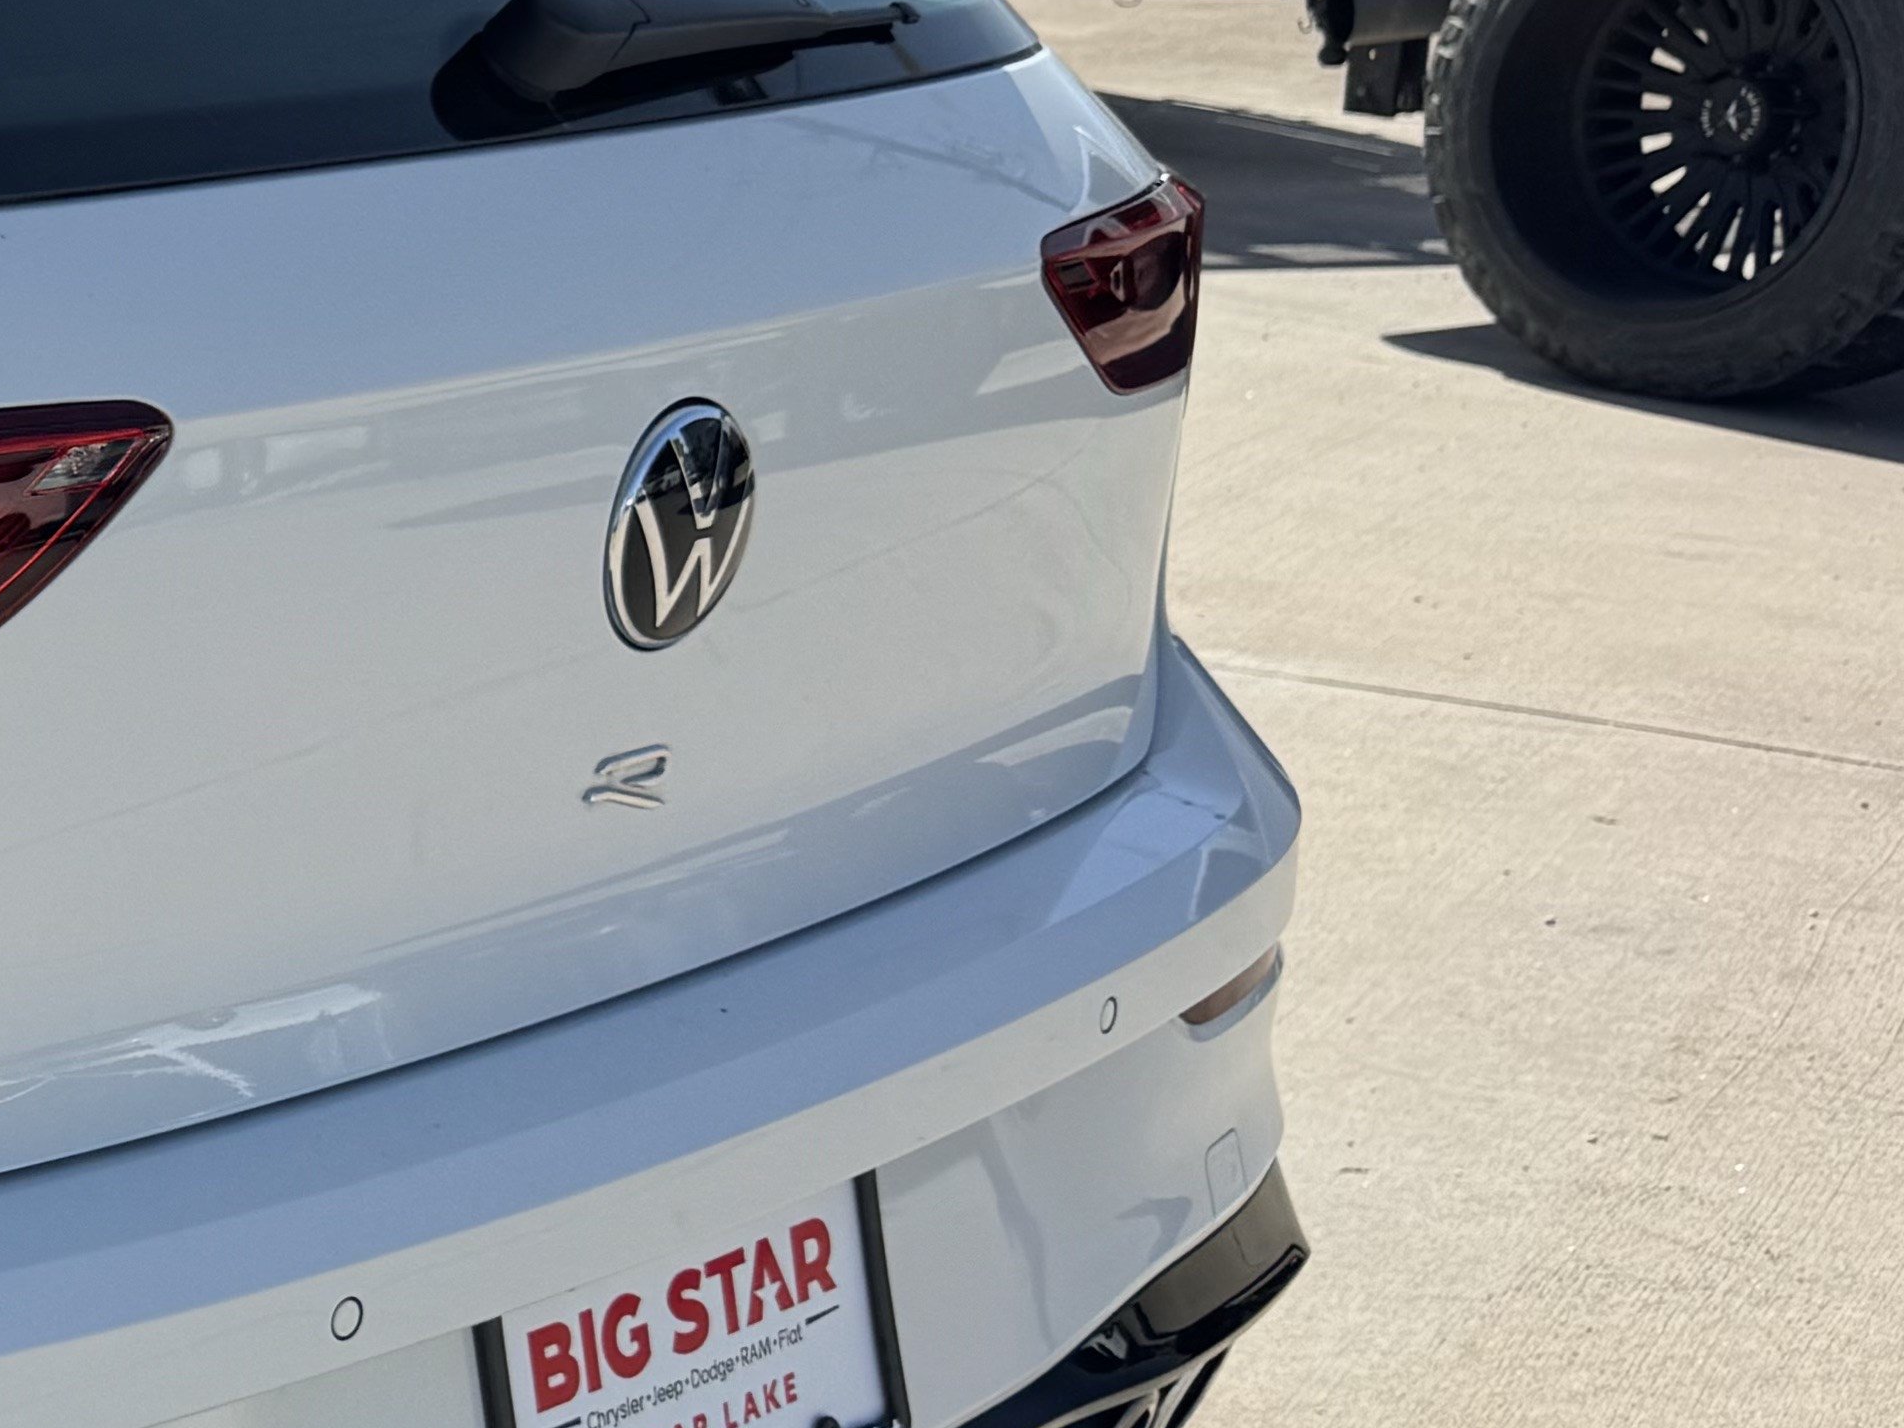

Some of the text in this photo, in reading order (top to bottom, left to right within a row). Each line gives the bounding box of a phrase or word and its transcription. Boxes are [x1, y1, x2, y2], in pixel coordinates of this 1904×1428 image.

[582, 743, 672, 810] R
[527, 1217, 837, 1414] BIG STAR
